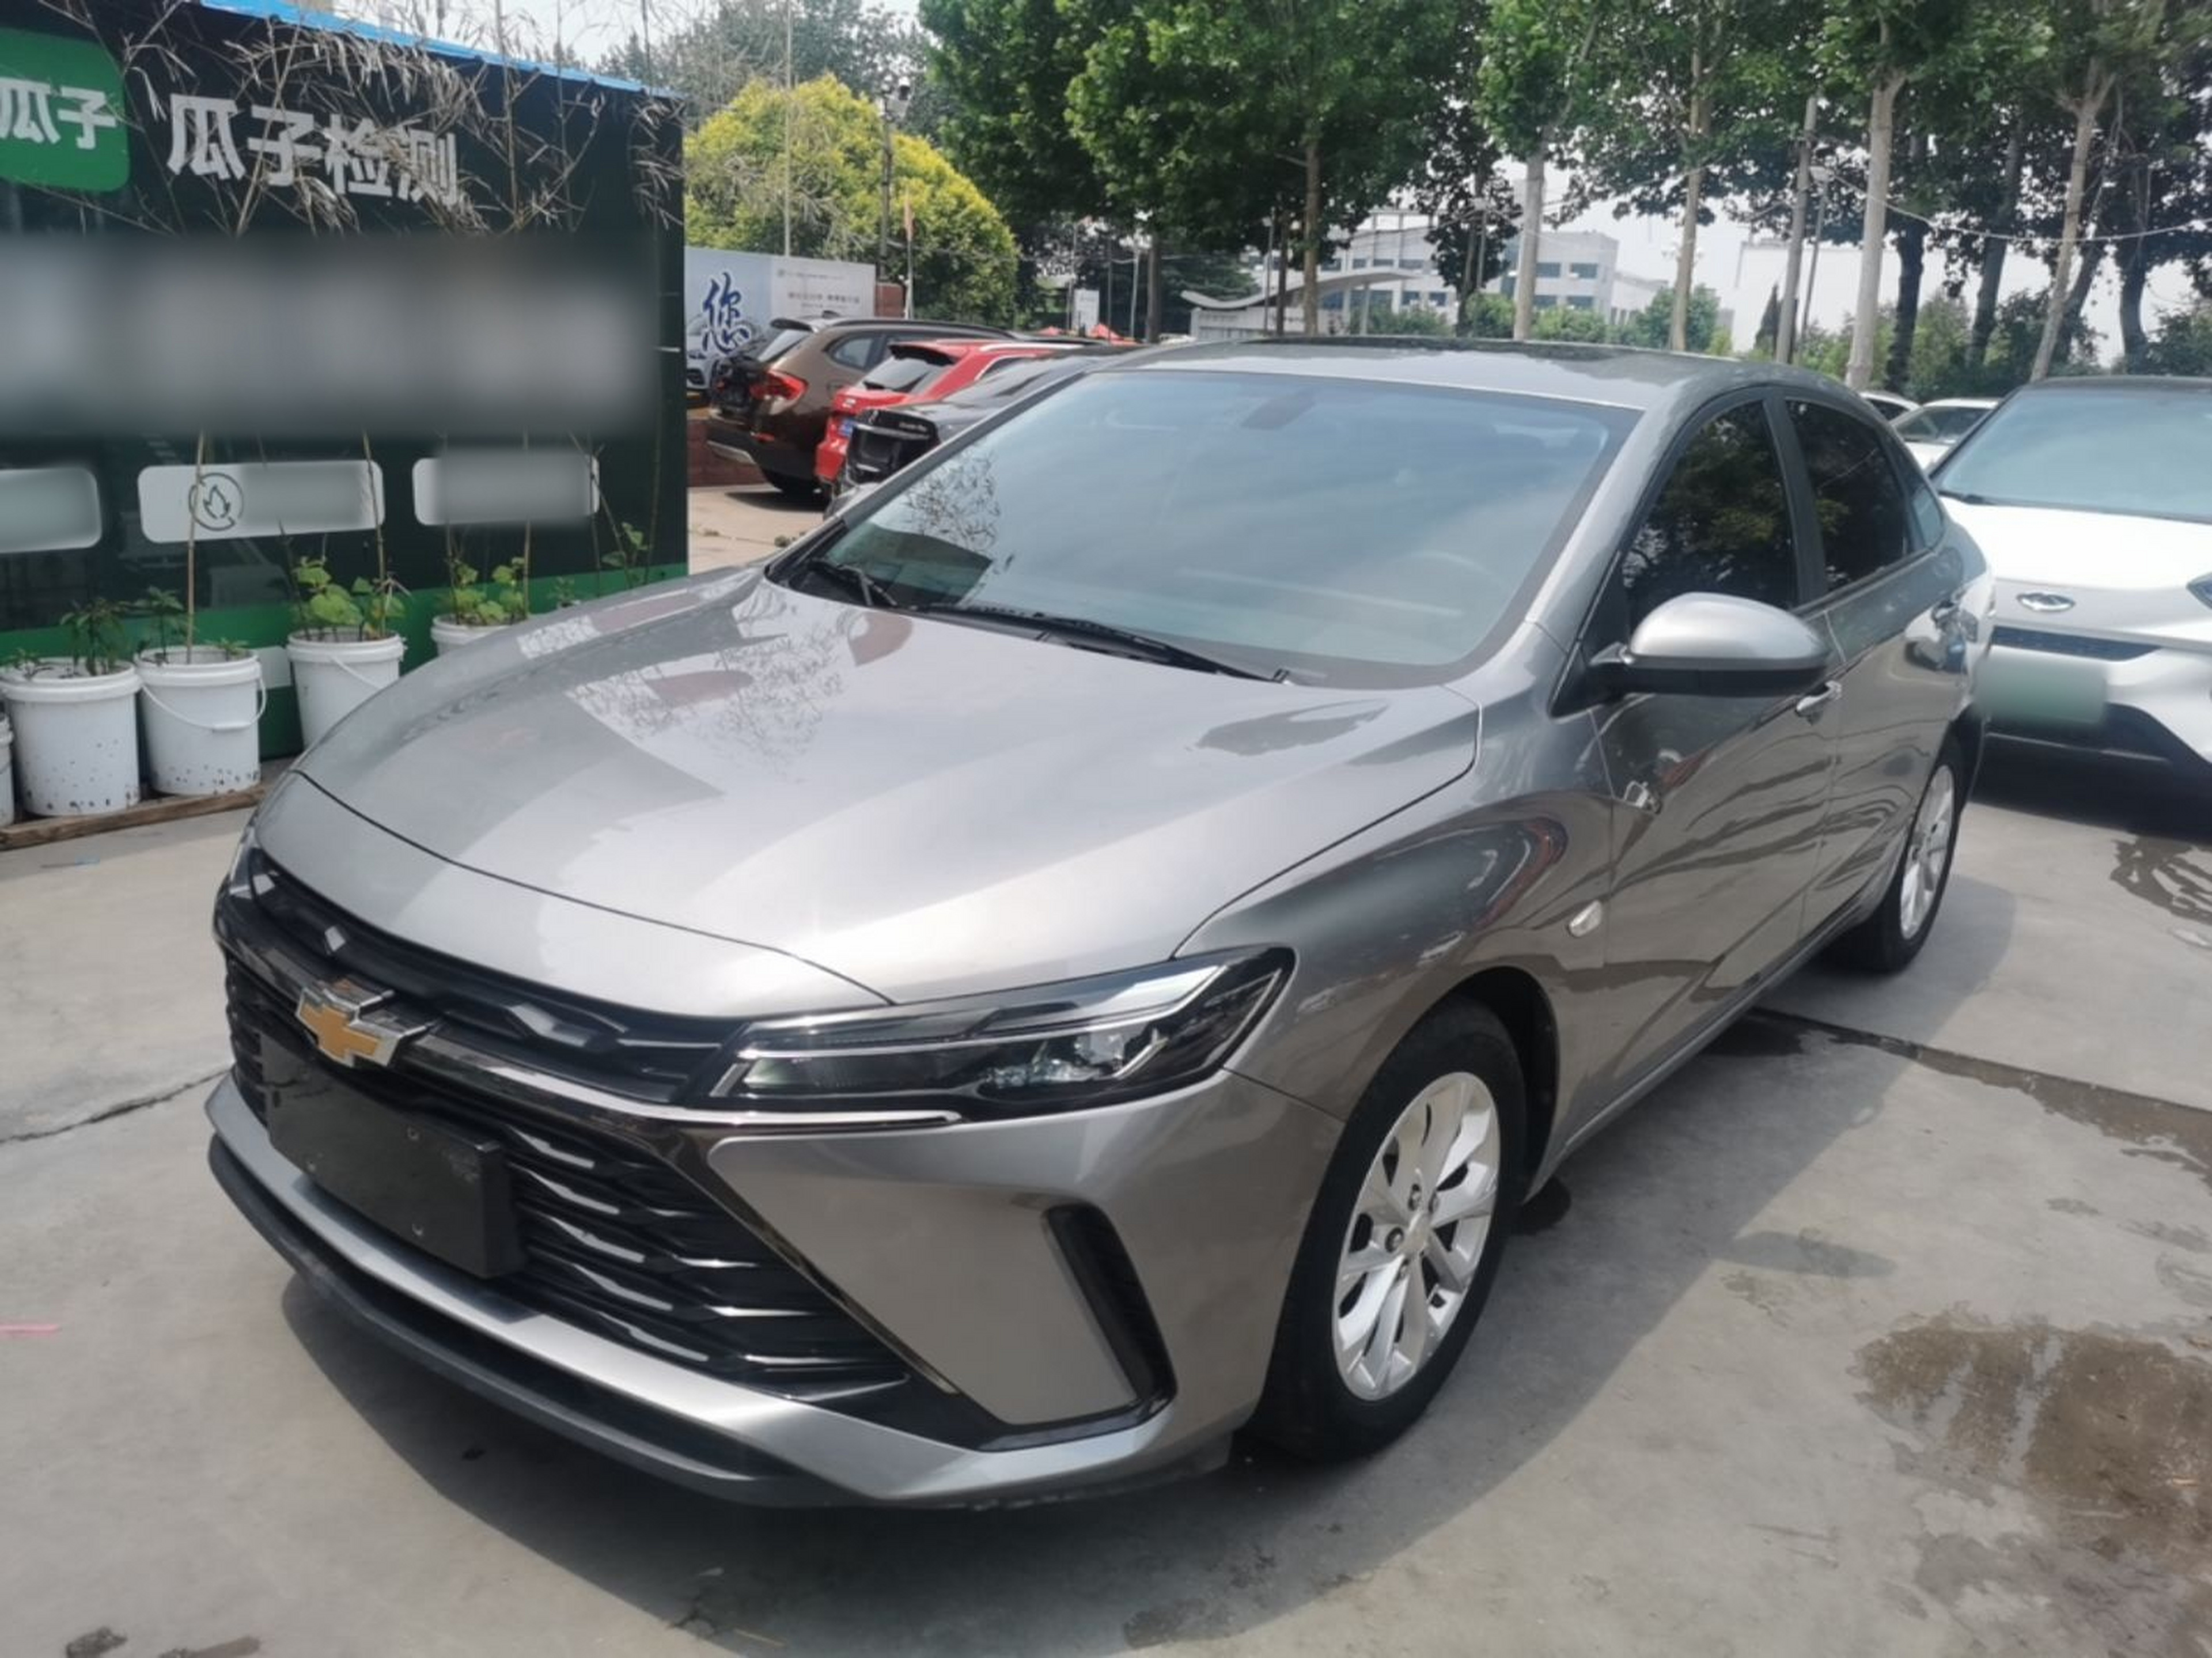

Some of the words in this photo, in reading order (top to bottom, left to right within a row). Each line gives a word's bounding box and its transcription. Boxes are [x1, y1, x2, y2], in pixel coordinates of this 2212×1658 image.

[0, 77, 116, 150] 瓜子
[167, 93, 457, 206] 瓜子检测
